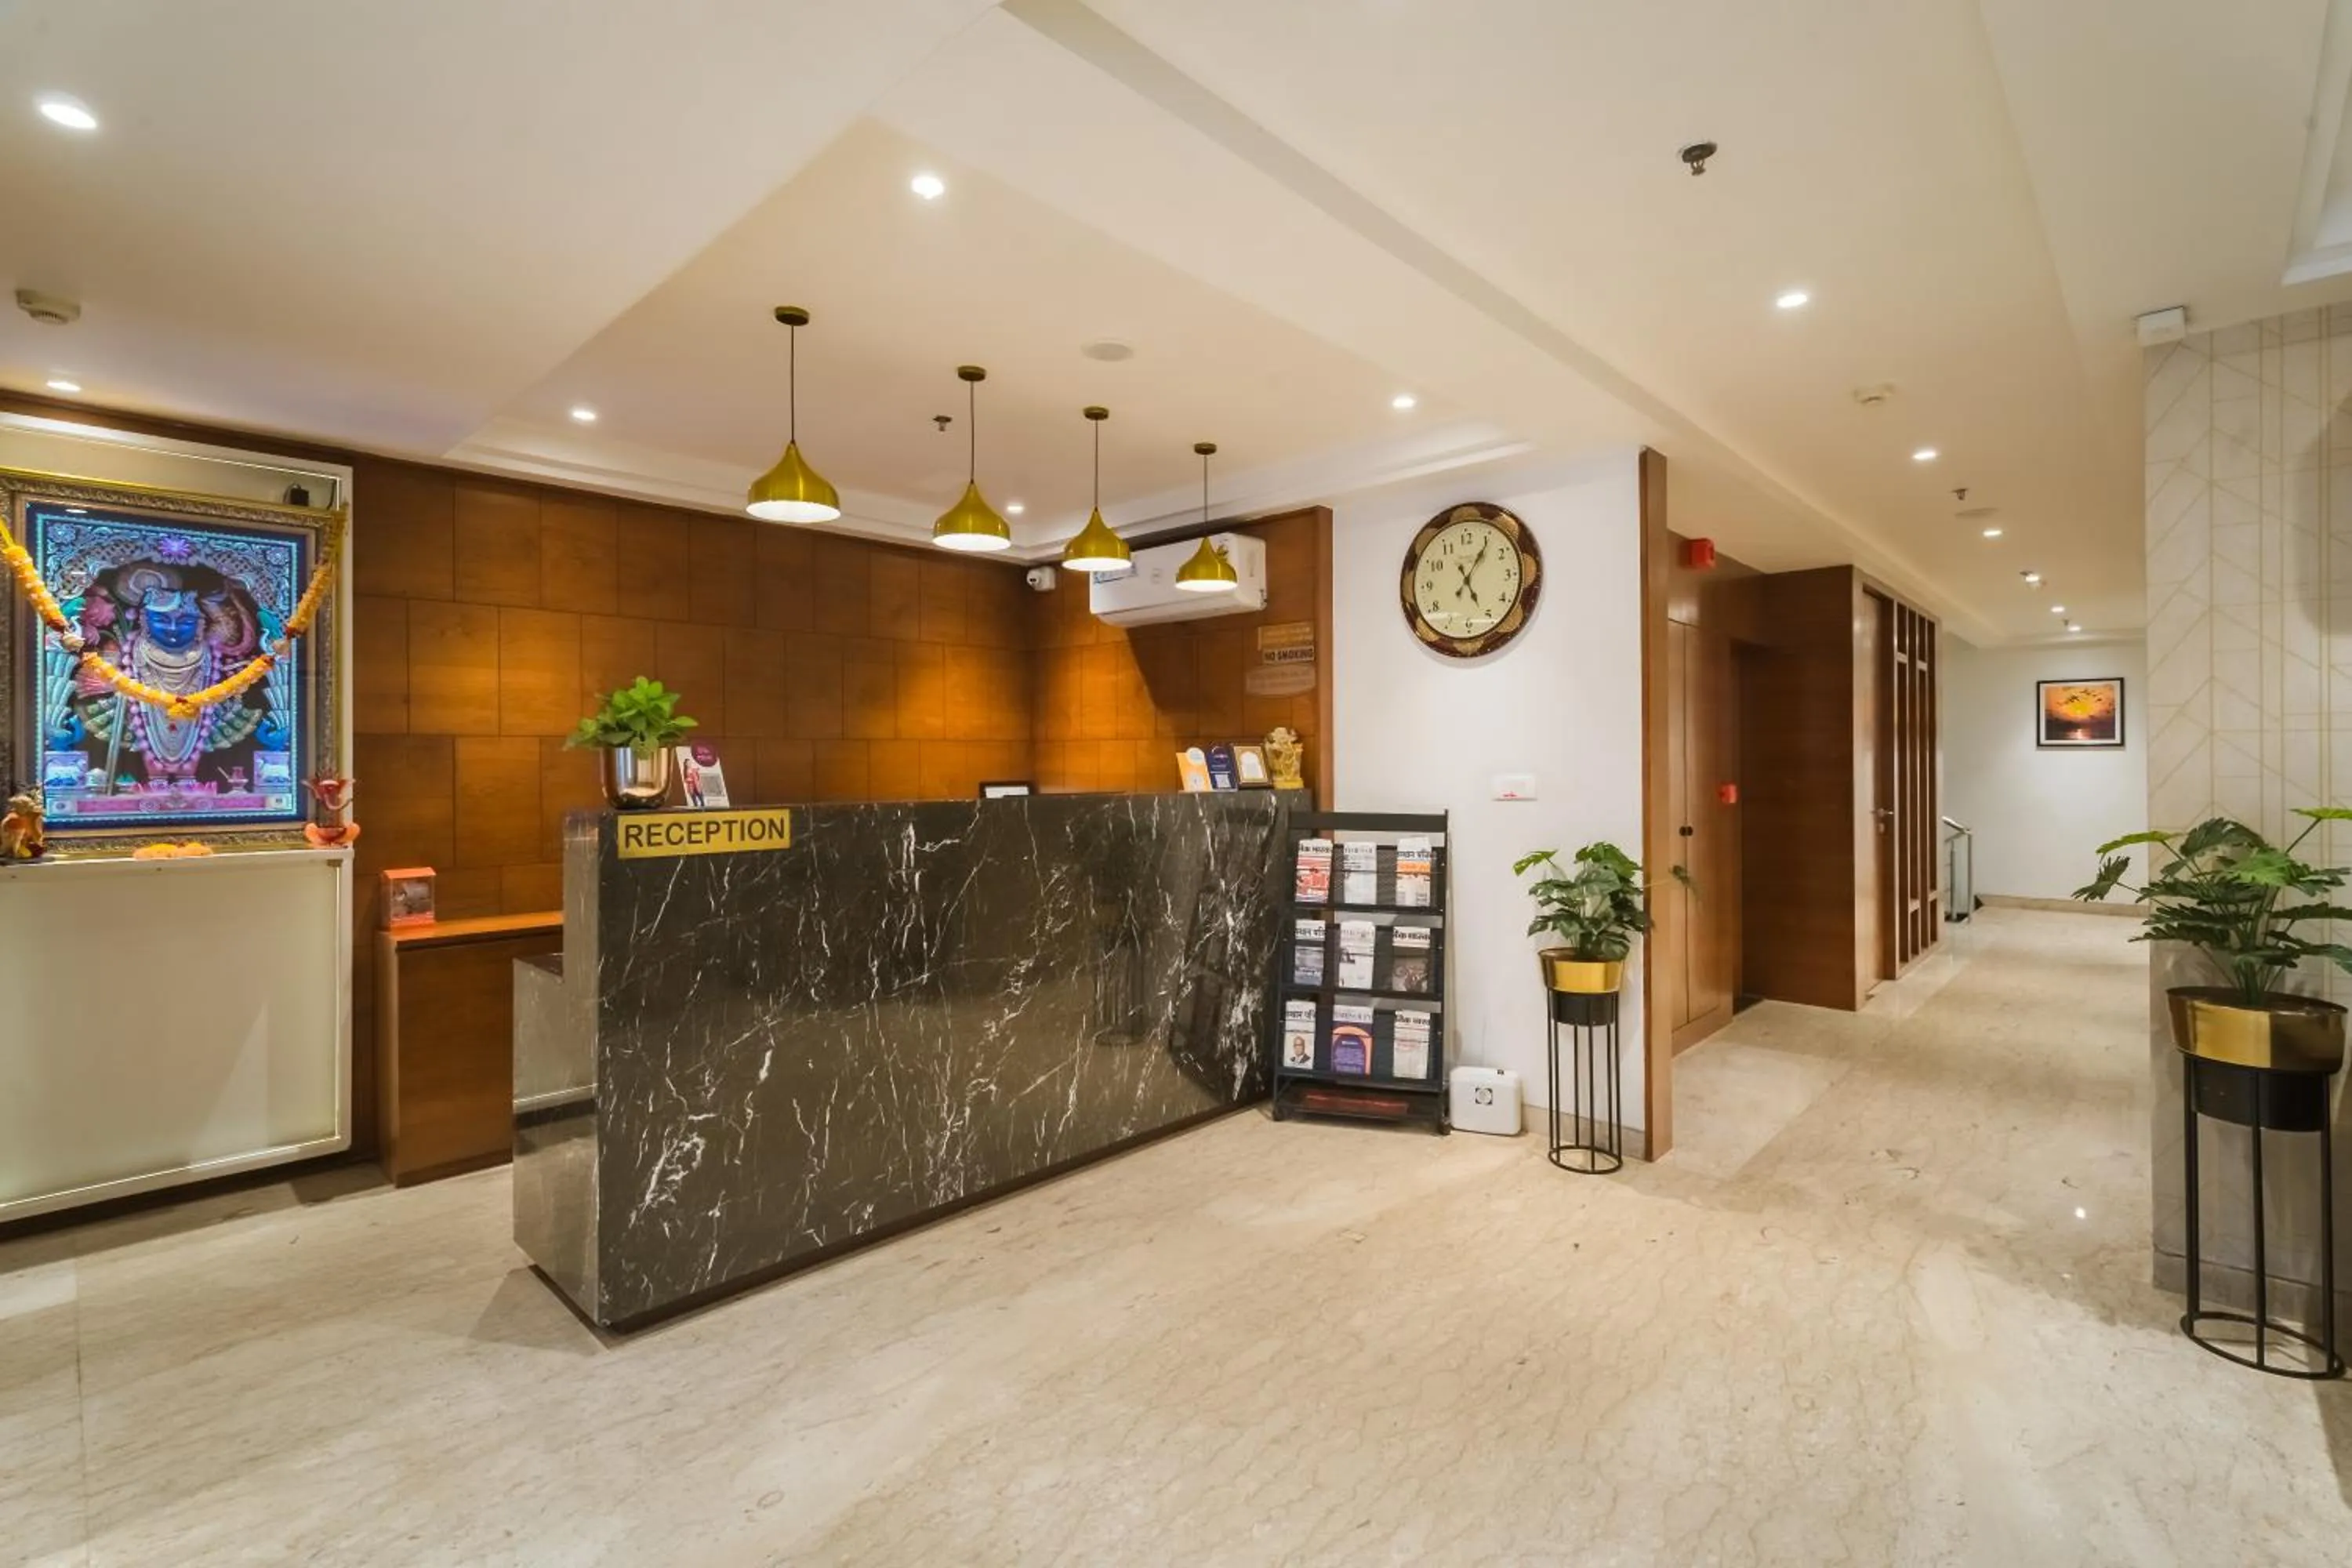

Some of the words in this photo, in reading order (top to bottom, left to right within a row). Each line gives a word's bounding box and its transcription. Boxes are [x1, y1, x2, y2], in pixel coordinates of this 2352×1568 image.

[1461, 532, 1473, 546] 12
[1443, 543, 1454, 555] 11
[1498, 549, 1505, 561] 2
[1431, 560, 1443, 572] 10
[1504, 569, 1512, 582] 3
[1425, 580, 1433, 591] 9
[1499, 592, 1506, 603] 4
[1432, 600, 1440, 612] 8
[1264, 652, 1276, 661] NO
[1277, 648, 1314, 661] SMOKING
[625, 818, 785, 848] RECEPTION
